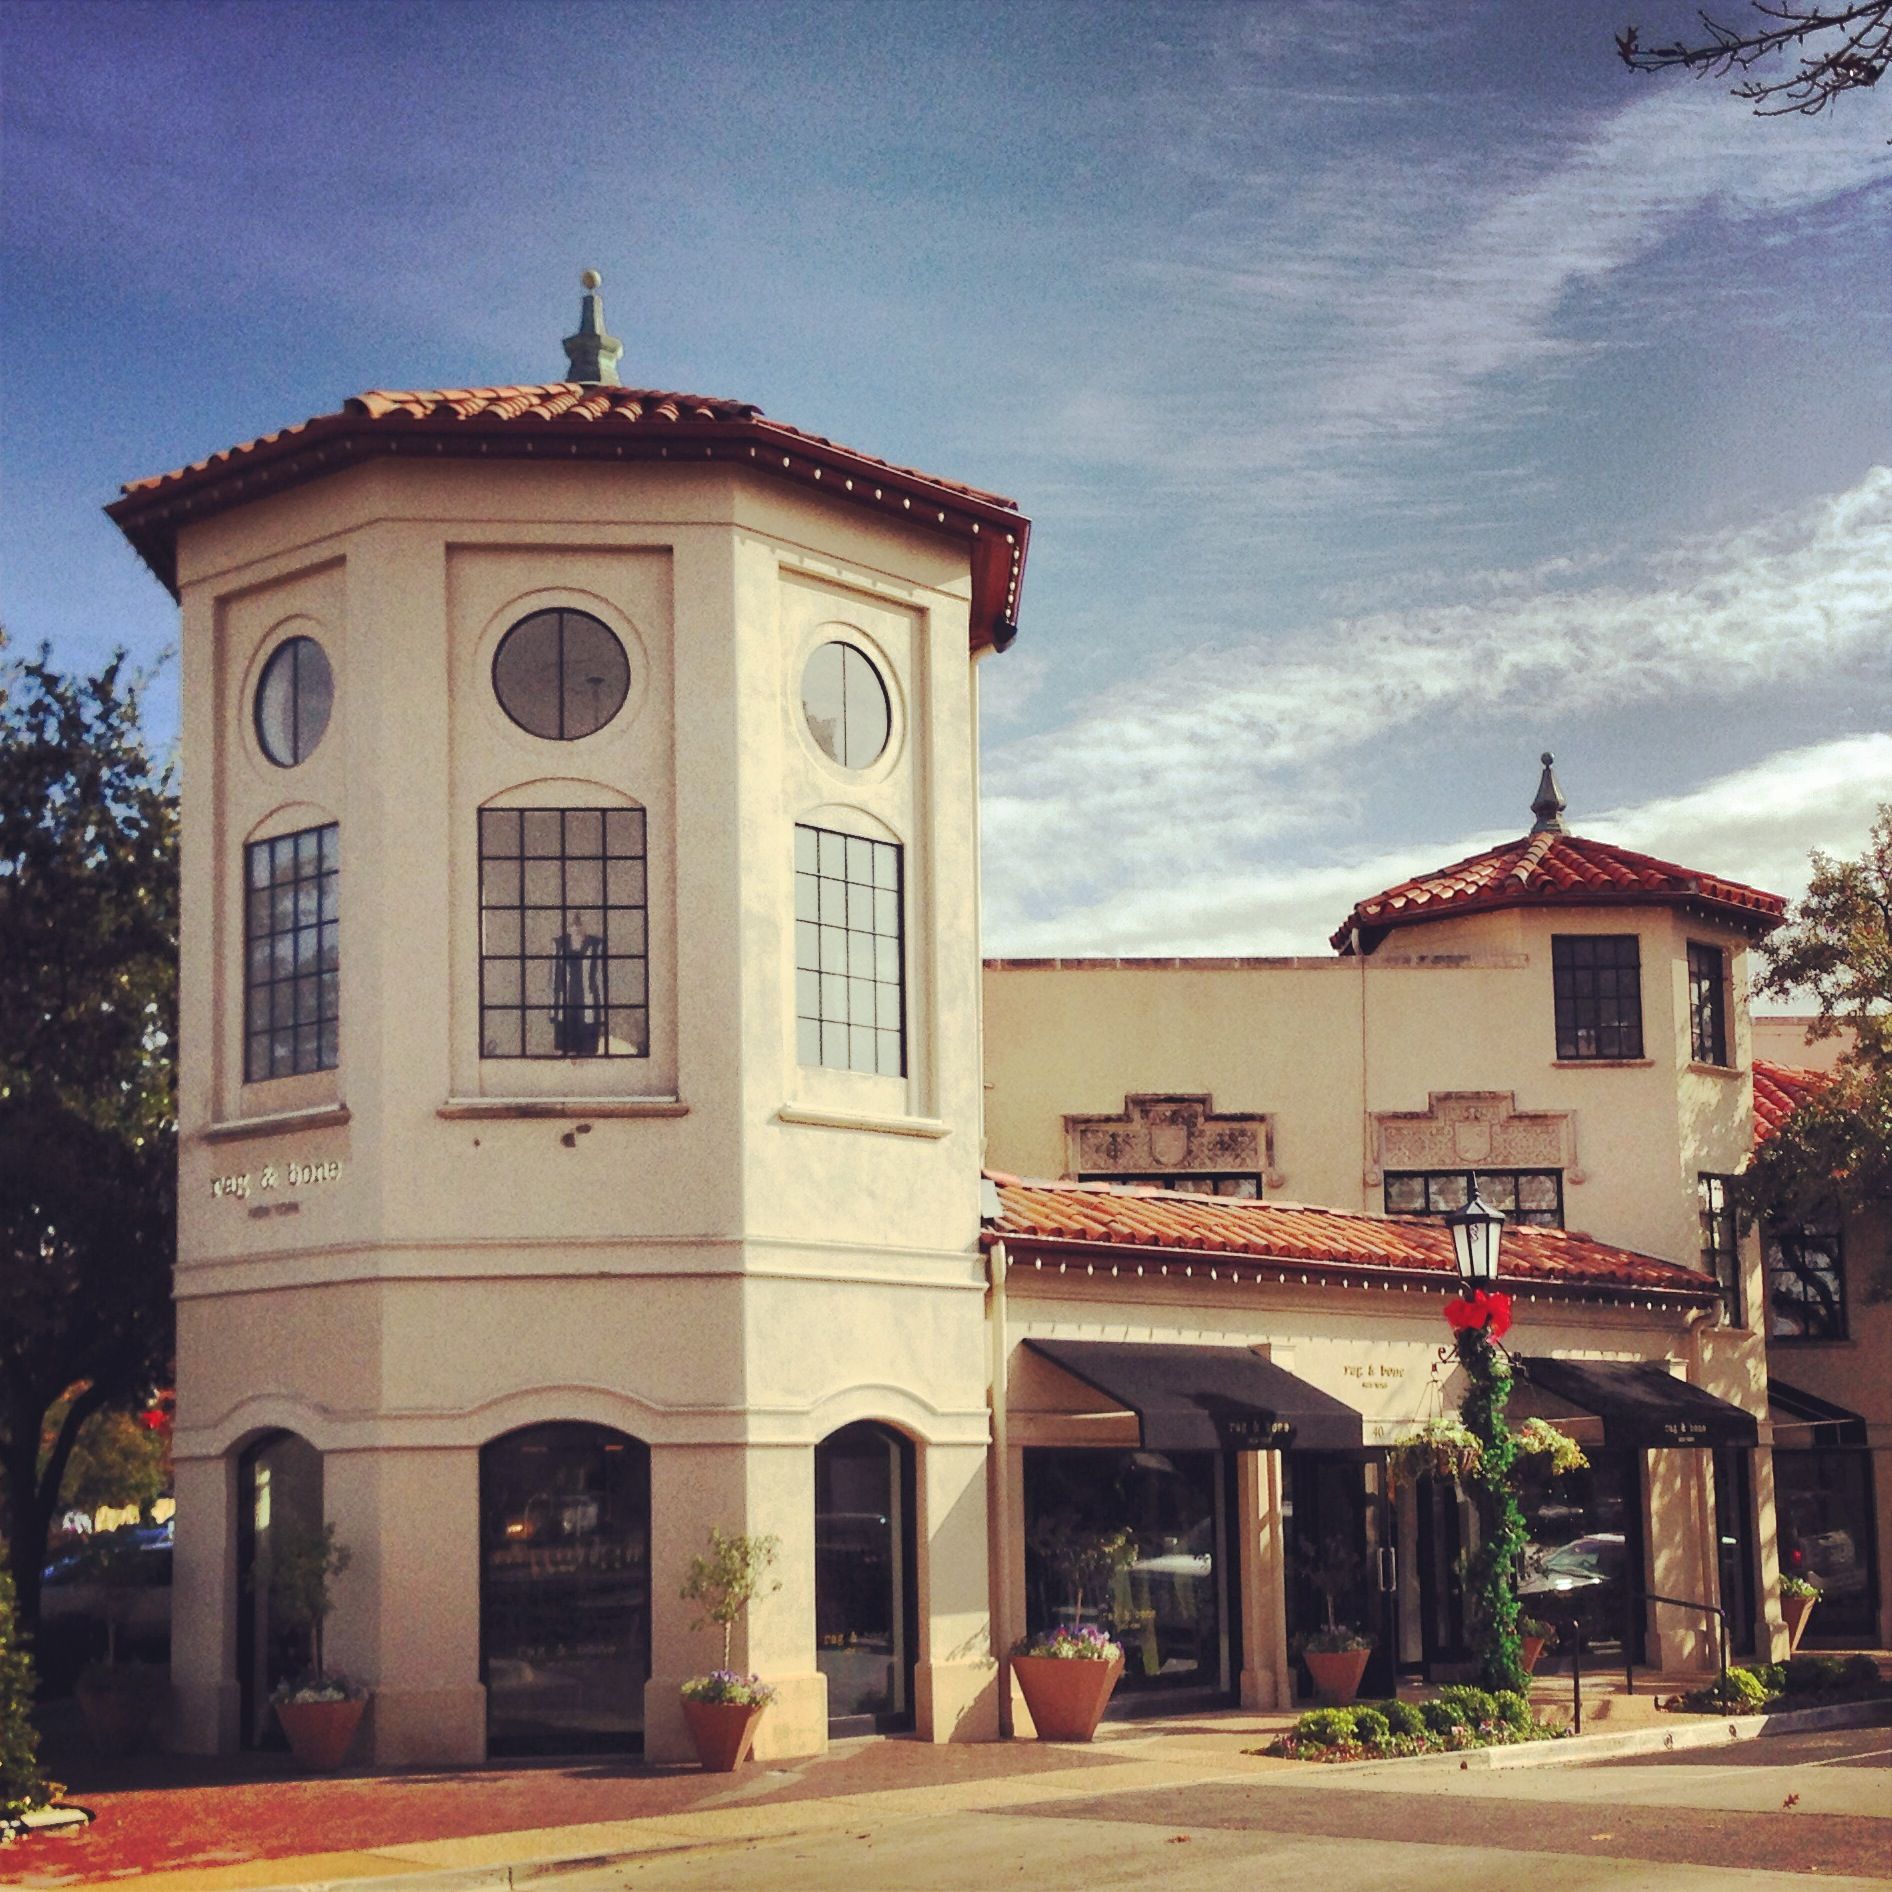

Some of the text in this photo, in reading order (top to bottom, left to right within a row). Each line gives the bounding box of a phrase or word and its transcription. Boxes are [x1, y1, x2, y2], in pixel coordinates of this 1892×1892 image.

[210, 1160, 343, 1199] rag & bone
[1344, 1366, 1363, 1378] rag
